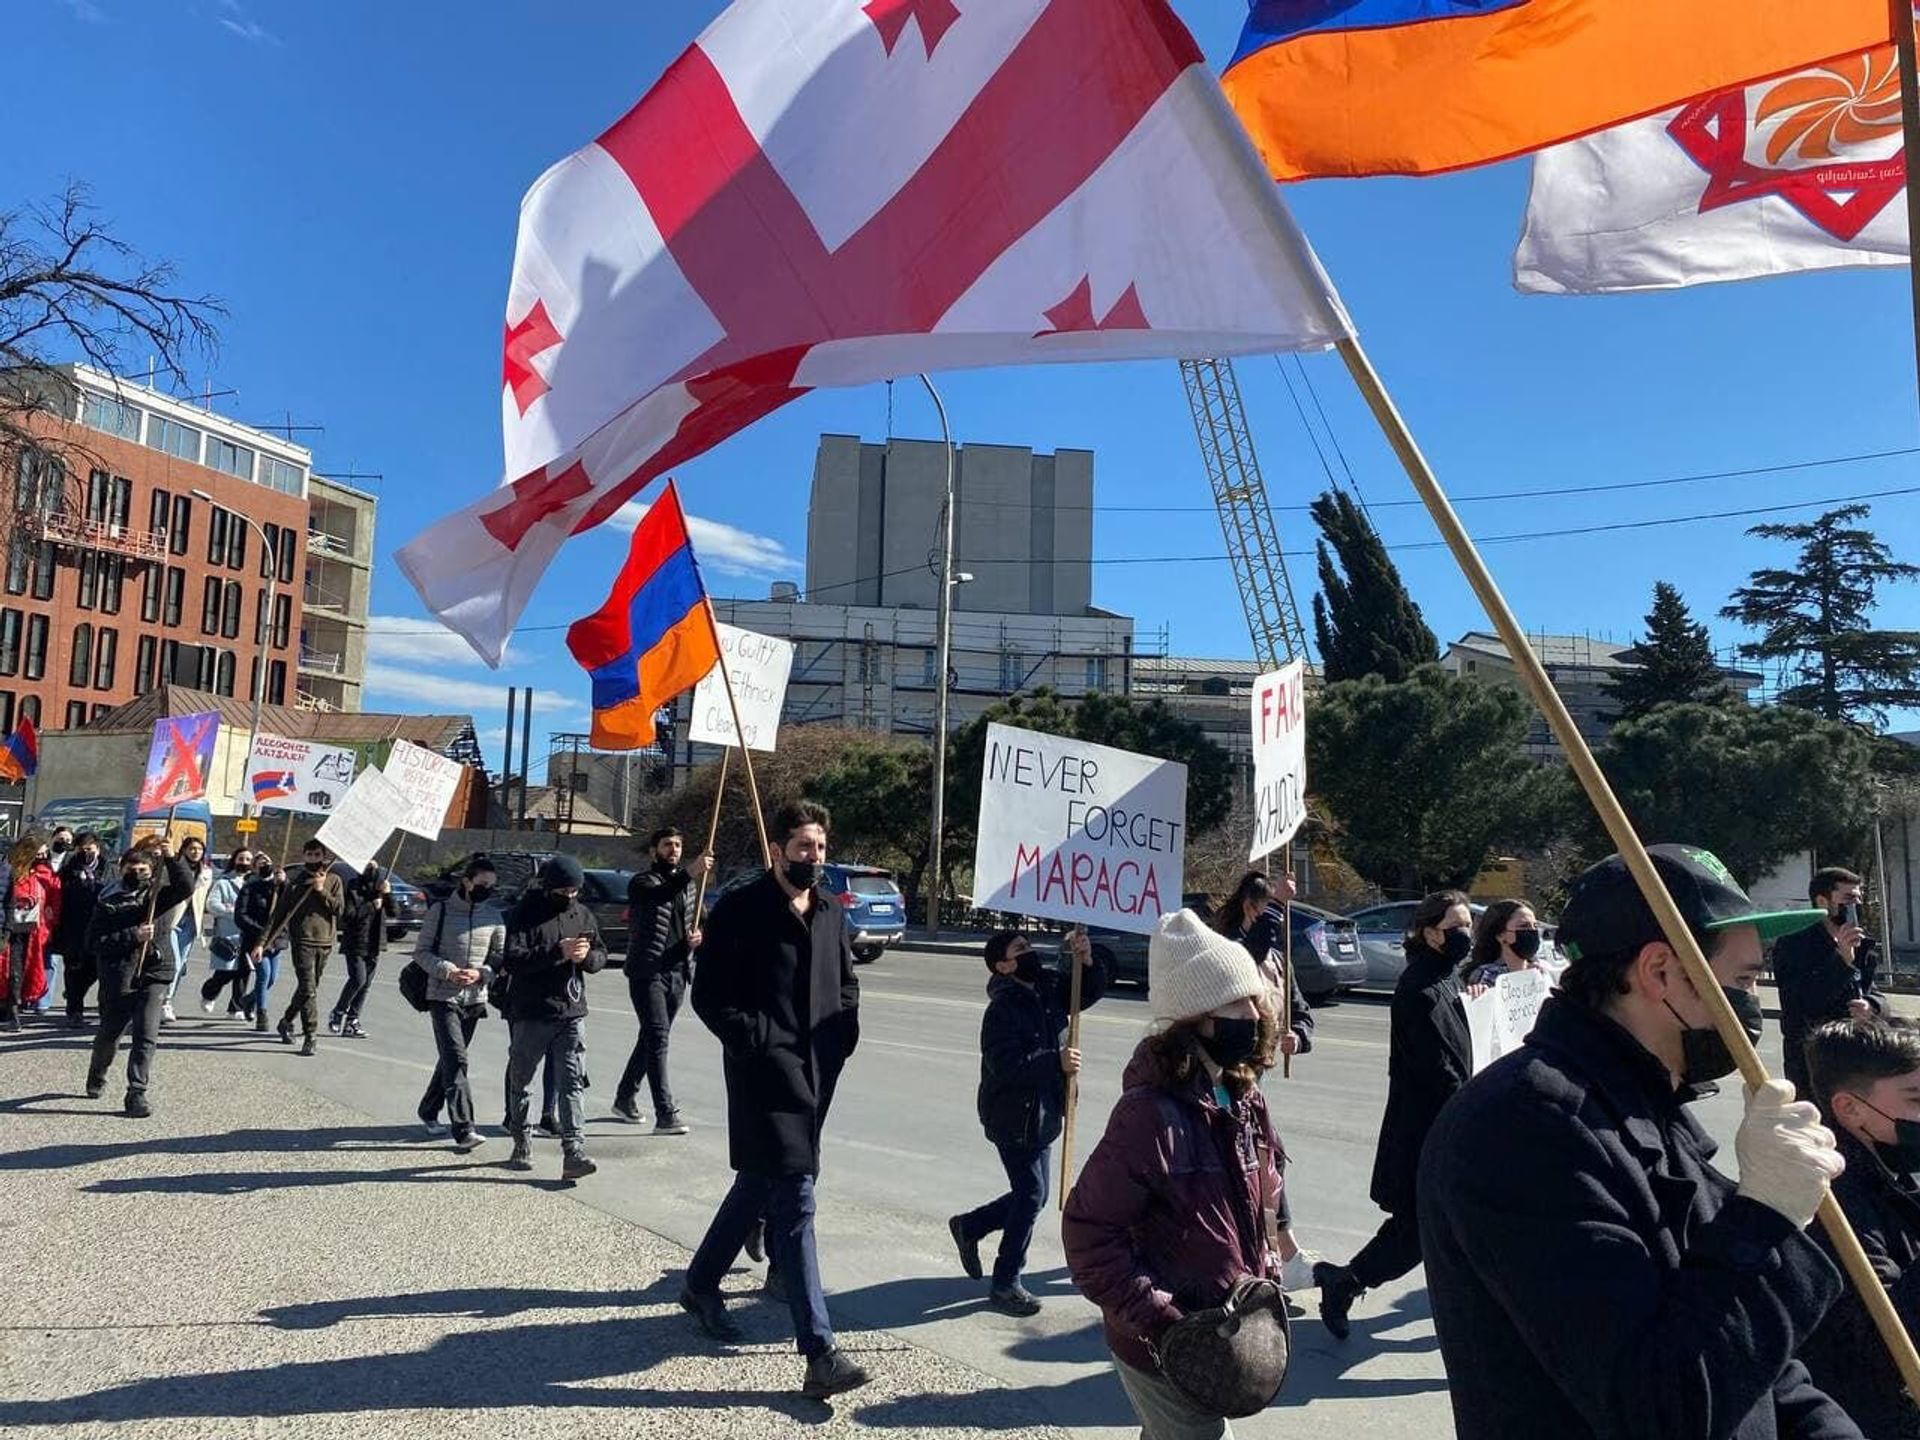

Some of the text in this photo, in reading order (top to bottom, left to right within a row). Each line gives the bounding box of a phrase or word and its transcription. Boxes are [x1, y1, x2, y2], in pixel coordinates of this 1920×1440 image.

[989, 741, 1099, 795] NEVER
[1066, 800, 1182, 853] FORGET
[1010, 842, 1162, 916] MARAGA
